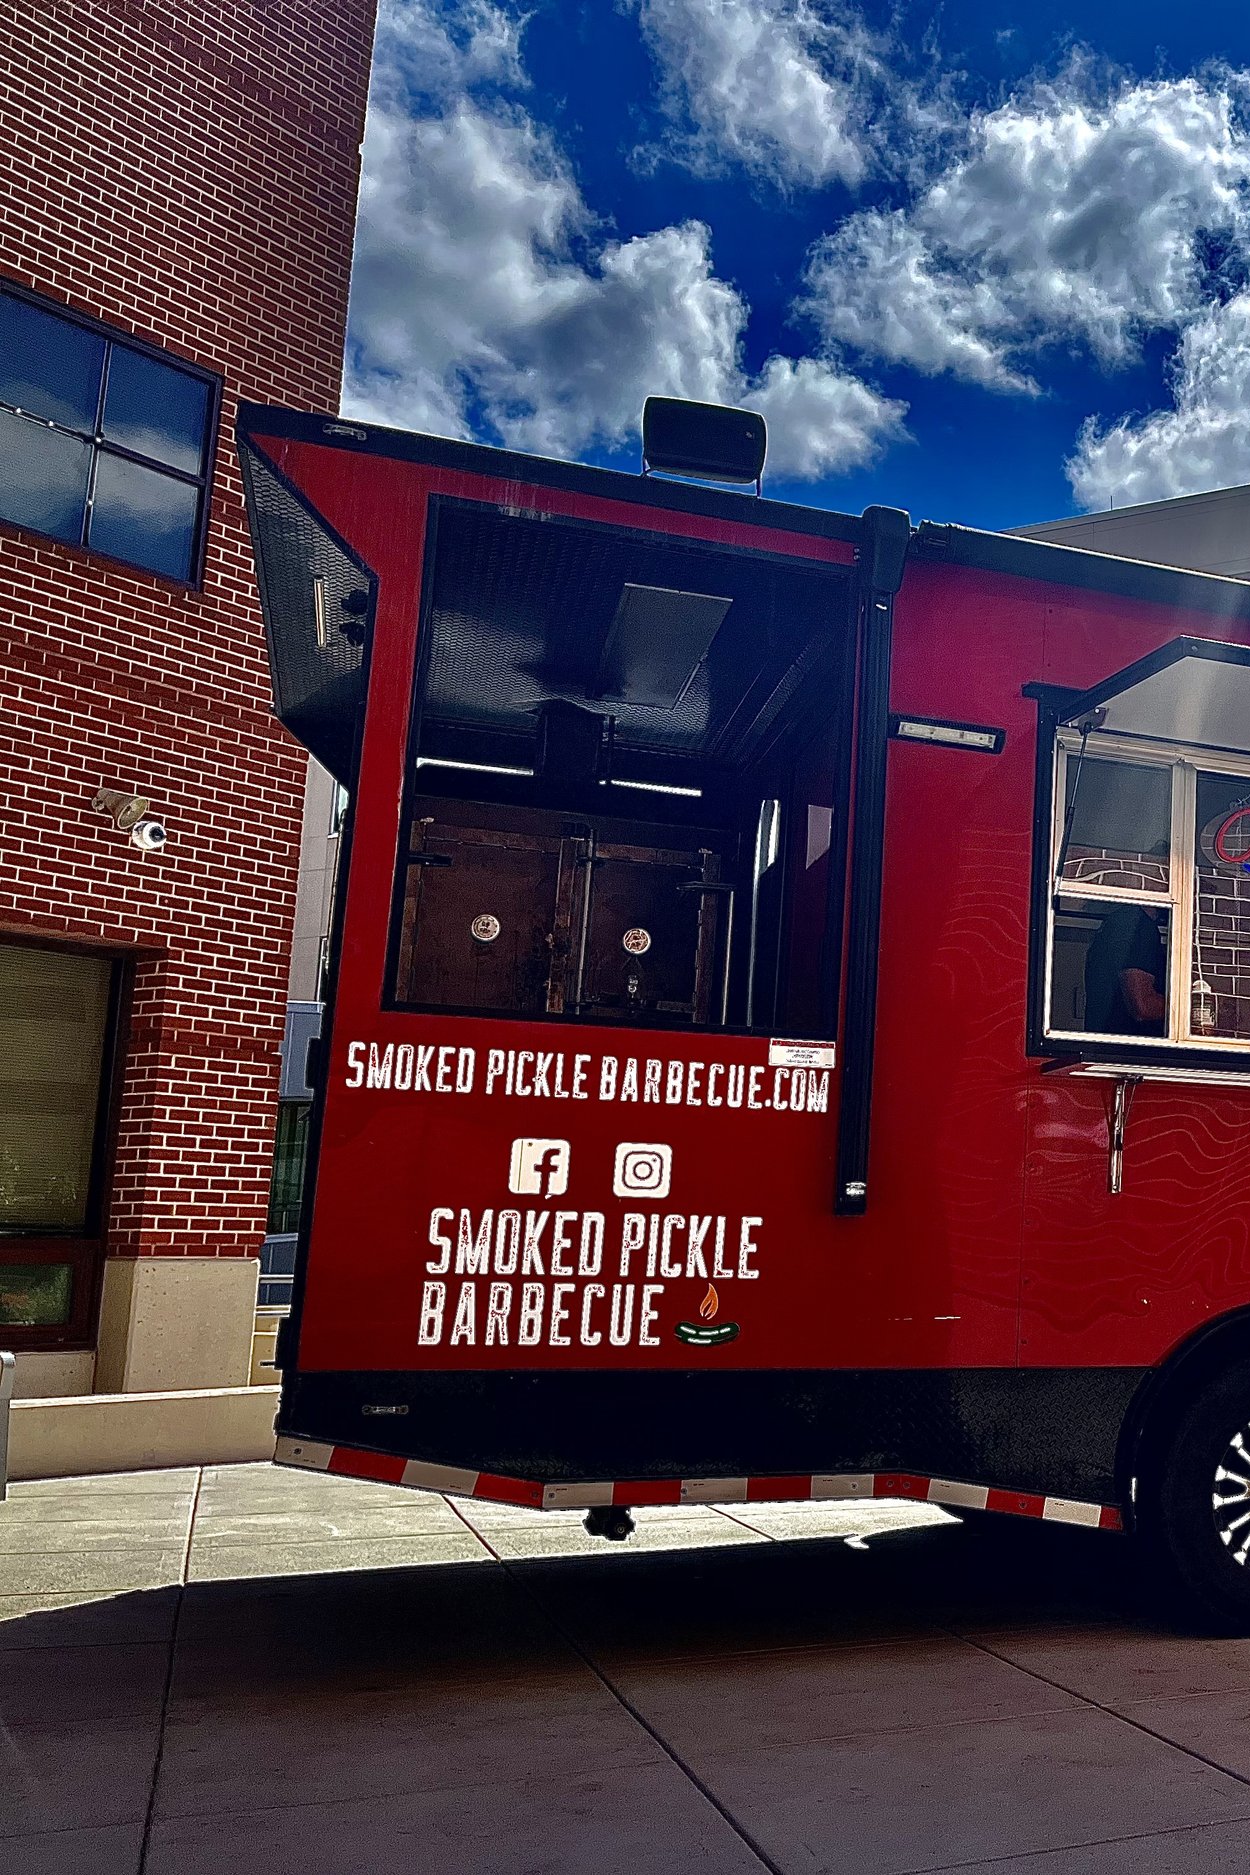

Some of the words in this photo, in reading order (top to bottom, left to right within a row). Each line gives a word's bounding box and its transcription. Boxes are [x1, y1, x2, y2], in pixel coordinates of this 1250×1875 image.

[345, 1041, 475, 1094] SMOKED
[485, 1046, 591, 1099] PICKLE
[599, 1055, 830, 1113] BARBECUE.COM
[425, 1207, 606, 1277] SMOKED
[619, 1213, 763, 1279] PICKLE
[417, 1281, 664, 1347] BARBECUE
